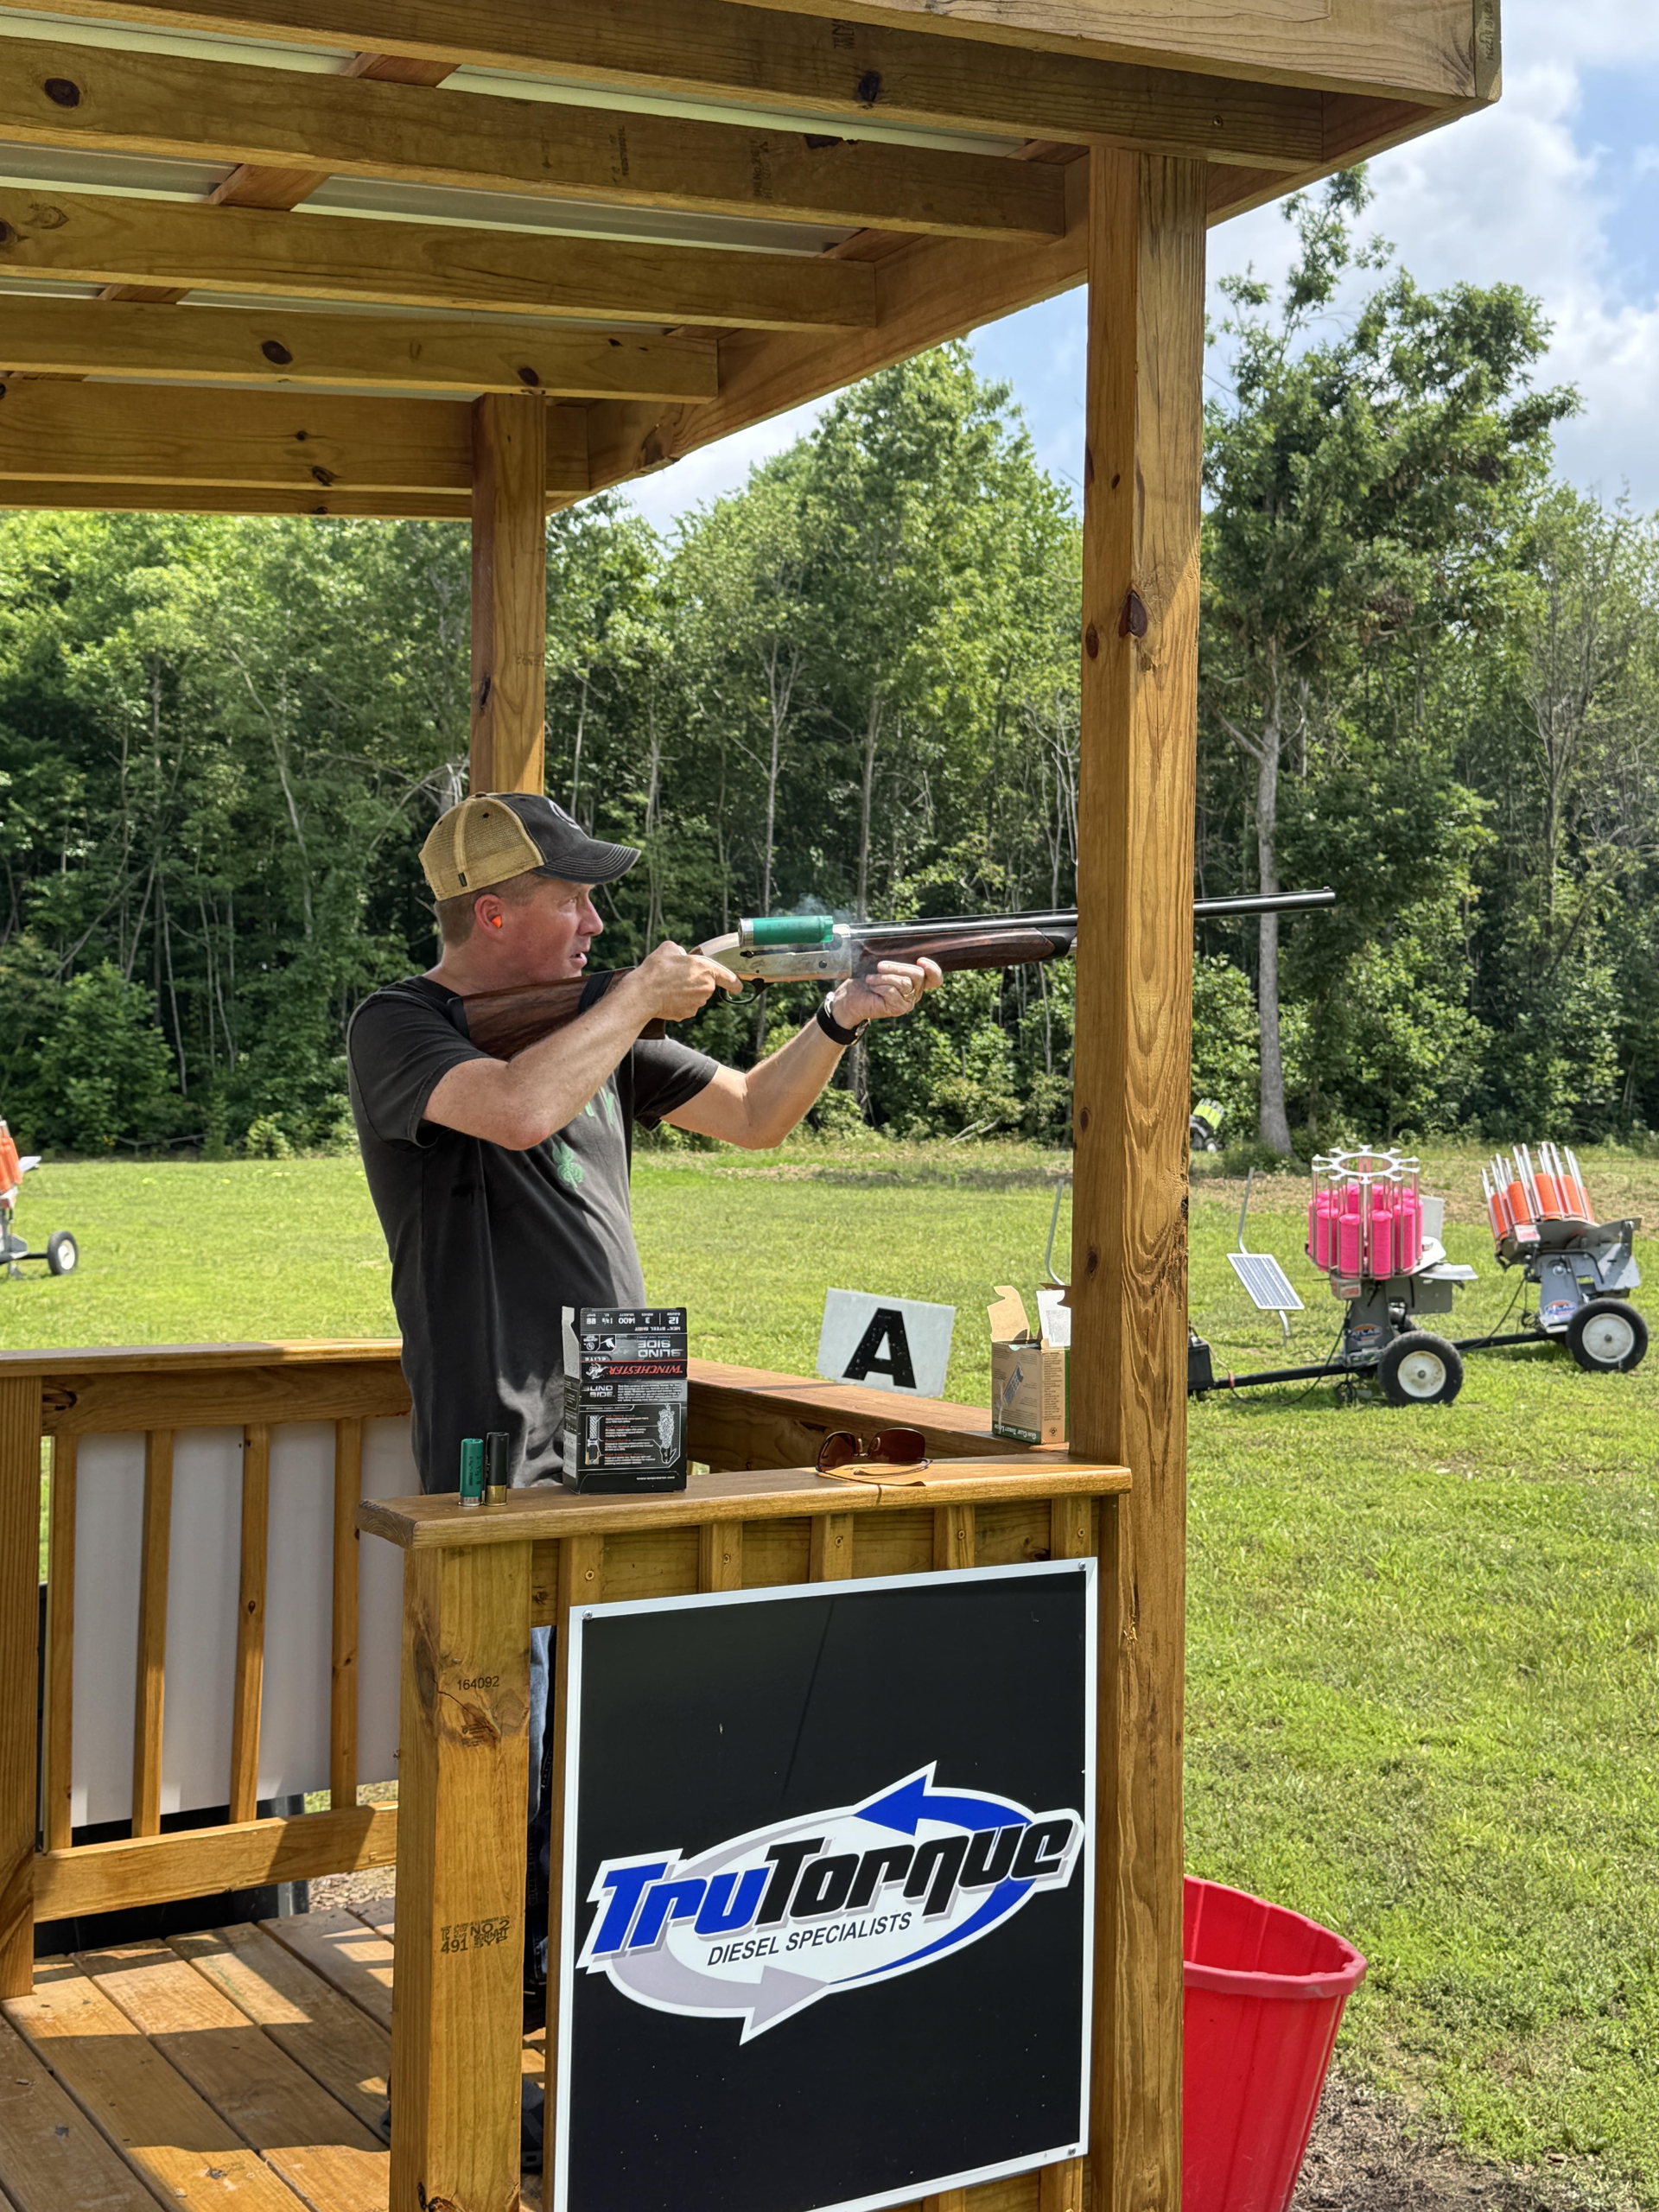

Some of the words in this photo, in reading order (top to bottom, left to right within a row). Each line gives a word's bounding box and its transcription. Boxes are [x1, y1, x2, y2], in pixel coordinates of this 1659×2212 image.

[668, 1316, 679, 1325] 12
[638, 1339, 671, 1348] SIDE
[842, 1306, 917, 1389] A
[608, 1364, 683, 1376] WINCHESTER
[457, 1675, 500, 1691] 164092
[591, 1818, 1075, 1955] TruTorque
[441, 1937, 468, 1954] 491
[707, 1936, 780, 1967] DIESEL
[785, 1911, 912, 1953] SPECIALISTS
